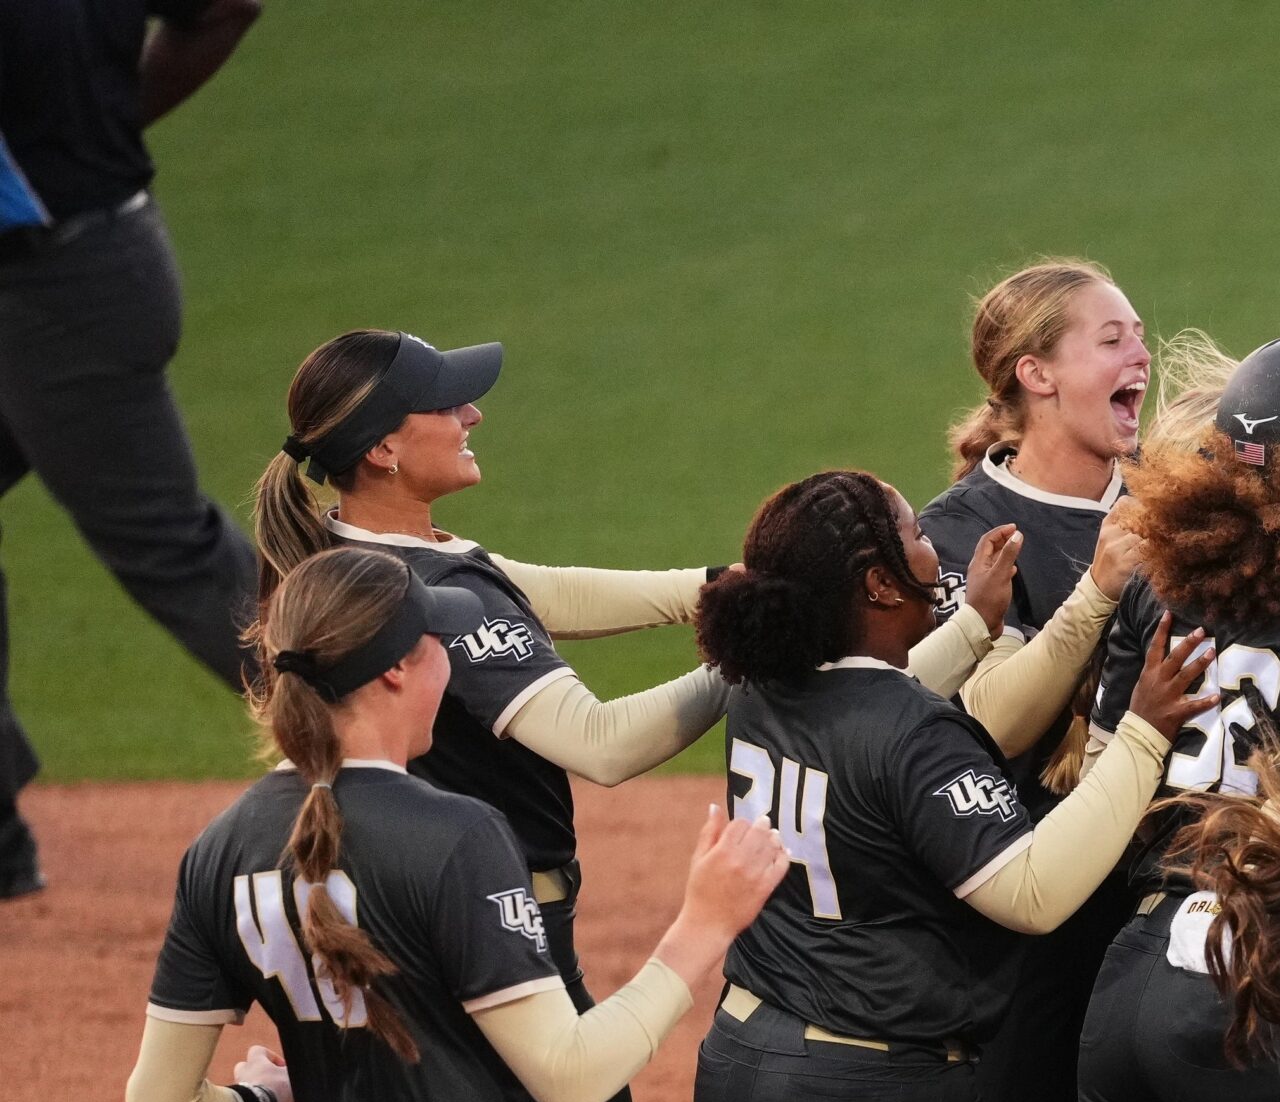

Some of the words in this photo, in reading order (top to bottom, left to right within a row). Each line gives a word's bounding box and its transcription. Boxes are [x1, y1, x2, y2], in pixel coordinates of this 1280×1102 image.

[450, 616, 534, 662] UCF
[932, 769, 1017, 822] UCF
[487, 888, 547, 952] UCF
